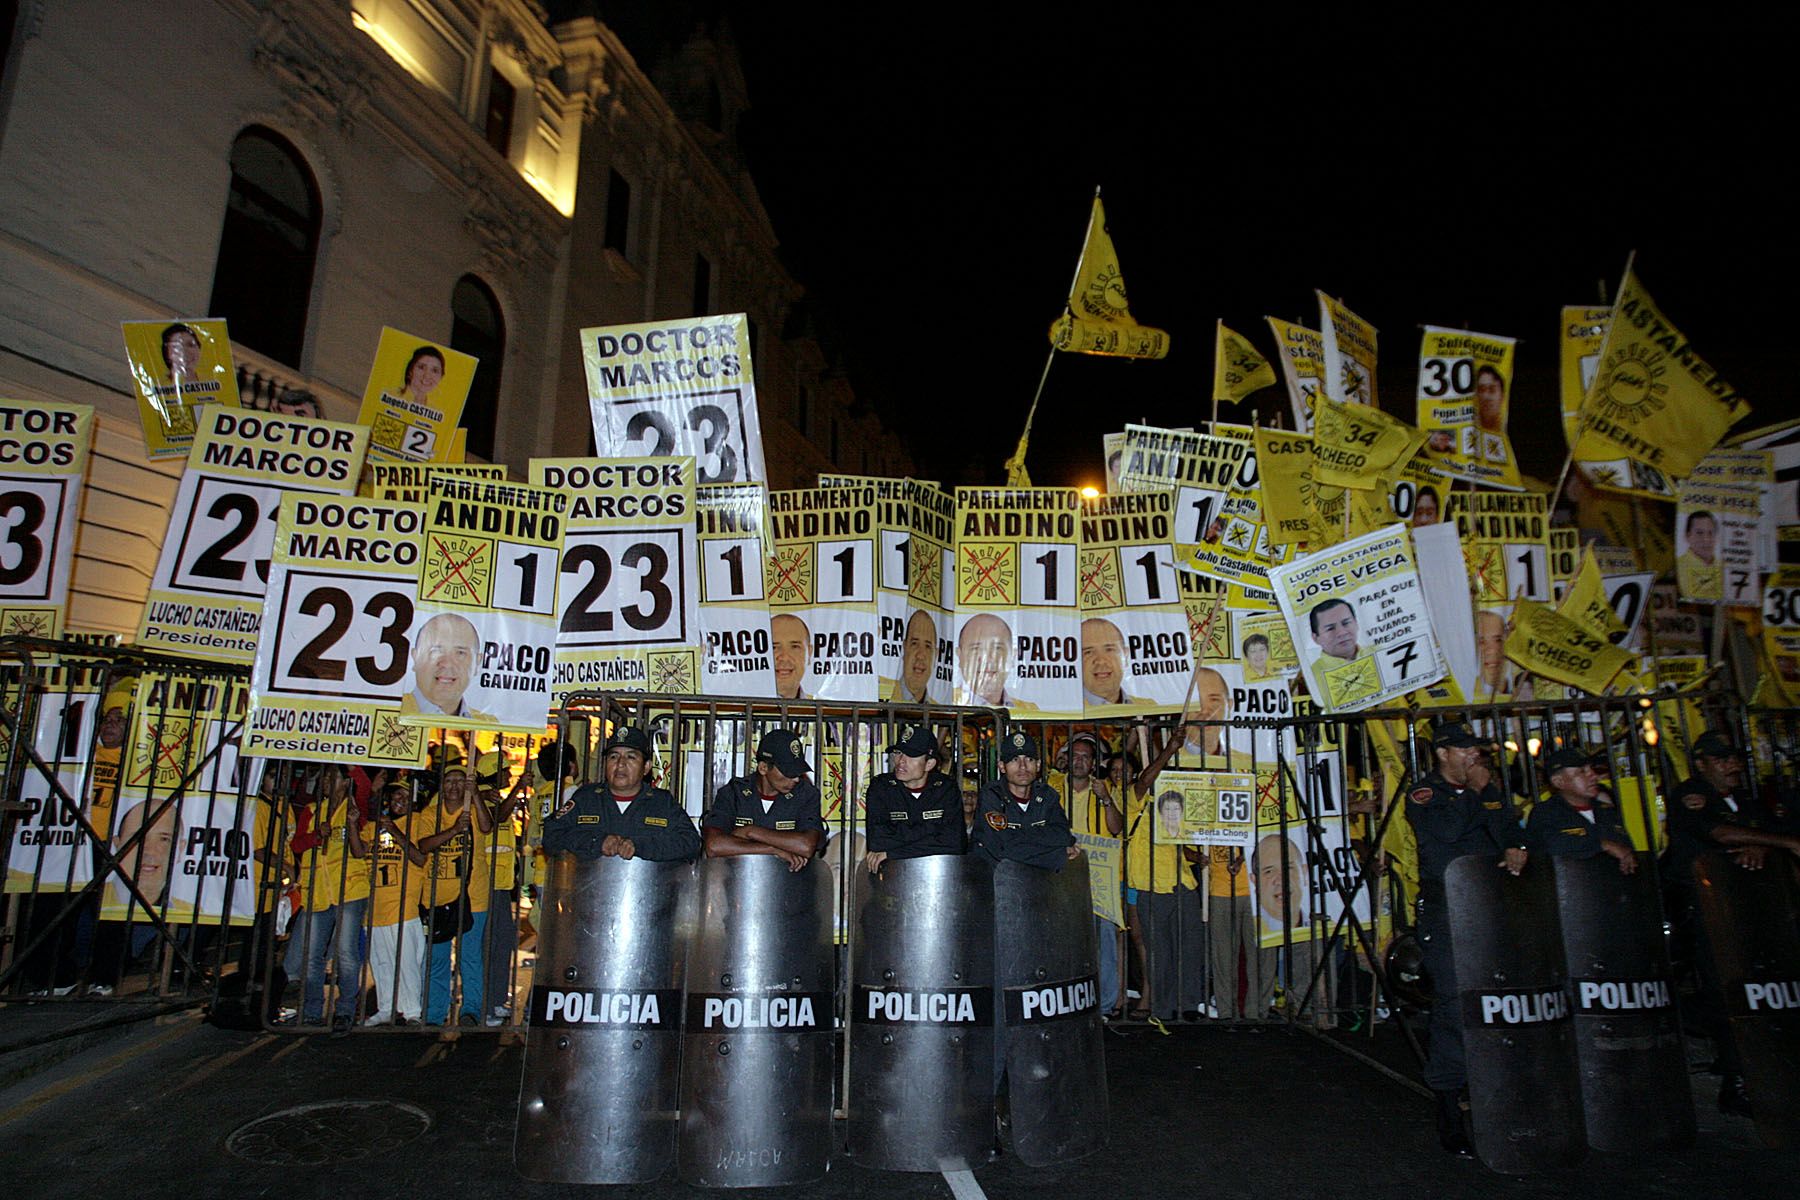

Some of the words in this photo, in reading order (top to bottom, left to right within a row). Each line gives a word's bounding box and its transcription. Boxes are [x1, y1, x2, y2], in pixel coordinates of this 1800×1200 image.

[597, 324, 737, 358] DOCTOR
[599, 354, 742, 389] MARCOS
[1423, 358, 1476, 397] 30
[409, 403, 444, 423] CASTILLO
[213, 413, 355, 454] DOCTOR
[408, 430, 428, 454] 2
[626, 404, 738, 483] 23
[1126, 428, 1244, 462] PARLAMENTO
[1342, 422, 1379, 448] 34
[203, 441, 350, 481] MARCOS
[1128, 449, 1235, 487] ANDINO
[544, 464, 684, 490] DOCTOR
[430, 476, 566, 514] PARLAMENTO
[569, 493, 686, 519] ARCOS
[770, 487, 875, 512] ARLAMENTO
[957, 489, 1079, 511] PARLAMENTO
[296, 502, 423, 534] DOCTO
[434, 500, 561, 542] ANDINO
[963, 511, 1075, 538] ANDINO
[1192, 495, 1216, 542] 1
[1458, 515, 1542, 539] ANDINO
[189, 492, 280, 584] 2
[288, 533, 421, 565] MARCO
[514, 552, 539, 607] 1
[720, 545, 745, 596] 1
[833, 546, 854, 597] 1
[1036, 549, 1058, 601] 1
[1135, 551, 1161, 600] 1
[1289, 562, 1329, 584] LUCHO
[1295, 574, 1348, 603] JOSE
[1351, 553, 1410, 580] VEGA
[1518, 550, 1535, 597] 1
[1730, 570, 1749, 599] 7
[559, 541, 673, 633] 23
[1359, 590, 1388, 605] PARA
[1390, 579, 1416, 594] QUE
[148, 600, 192, 626] LUCHO
[1376, 606, 1404, 623] LIMA
[1381, 597, 1395, 609] EN
[144, 626, 257, 652] Presidente
[287, 586, 414, 687] 23
[1366, 613, 1417, 638] VIVAMOS
[1373, 626, 1413, 645] MEJOR
[706, 628, 769, 657] PACO
[813, 631, 875, 658] PACO
[1017, 635, 1078, 662] PACO
[1127, 631, 1188, 660] PACO
[483, 641, 551, 675] PACO
[578, 655, 646, 683] CASTAÑEDA
[813, 660, 874, 675] GAVIDIA
[1017, 663, 1078, 679] GAVIDIA
[1131, 658, 1190, 677] GAVIDIA
[1386, 640, 1419, 680] 7
[480, 672, 547, 693] GAVIDIA
[1232, 688, 1290, 713] PACO
[59, 701, 85, 758] 1
[251, 706, 297, 732] LUCHO
[299, 709, 370, 738] CASTAÑEDA
[249, 733, 367, 756] Presidente
[19, 797, 80, 827] PAC
[1221, 792, 1249, 821] 35
[20, 829, 88, 847] GAVIDA
[1198, 828, 1221, 836] Berta
[1222, 828, 1249, 839] Chong
[378, 864, 389, 886] 1
[545, 990, 662, 1025] POLICIA
[867, 991, 976, 1023] POLICIA
[1022, 979, 1097, 1020] POLICIA
[1480, 990, 1568, 1024] POLICIA
[1578, 980, 1671, 1010] POLICIA
[703, 996, 816, 1029] POLICIA
